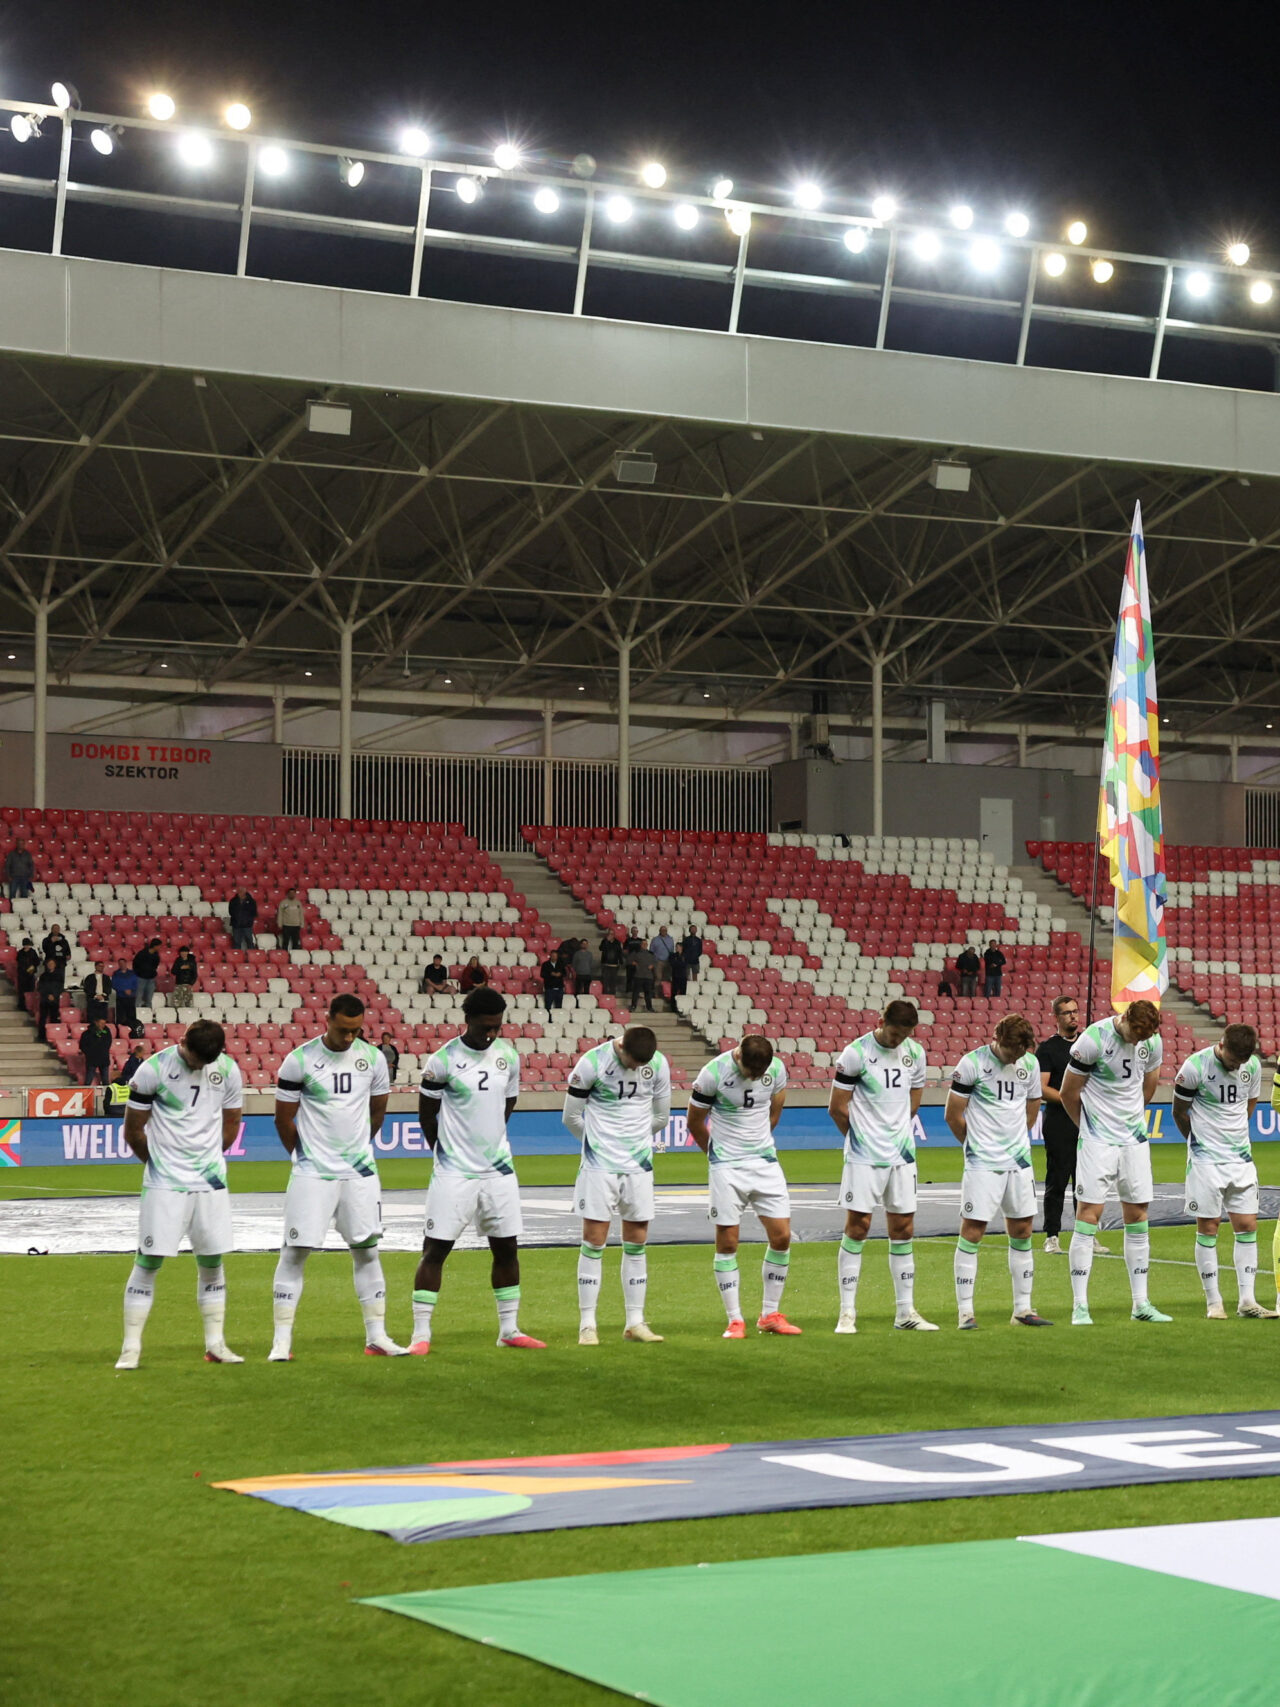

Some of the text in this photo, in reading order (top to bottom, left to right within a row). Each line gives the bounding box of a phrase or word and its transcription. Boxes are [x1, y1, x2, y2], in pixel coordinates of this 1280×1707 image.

[70, 742, 212, 765] DOMBI TIBOR
[104, 765, 179, 780] SZEKTOR
[884, 1068, 902, 1089] 12
[1122, 1059, 1132, 1079] 5
[332, 1073, 352, 1094] 10
[478, 1071, 489, 1091] 2
[618, 1080, 637, 1100] 17
[997, 1080, 1015, 1101] 14
[34, 1091, 87, 1117] C4
[190, 1086, 200, 1107] 7
[743, 1089, 755, 1109] 6
[1219, 1085, 1237, 1104] 18
[205, 1284, 225, 1292] ÉIR
